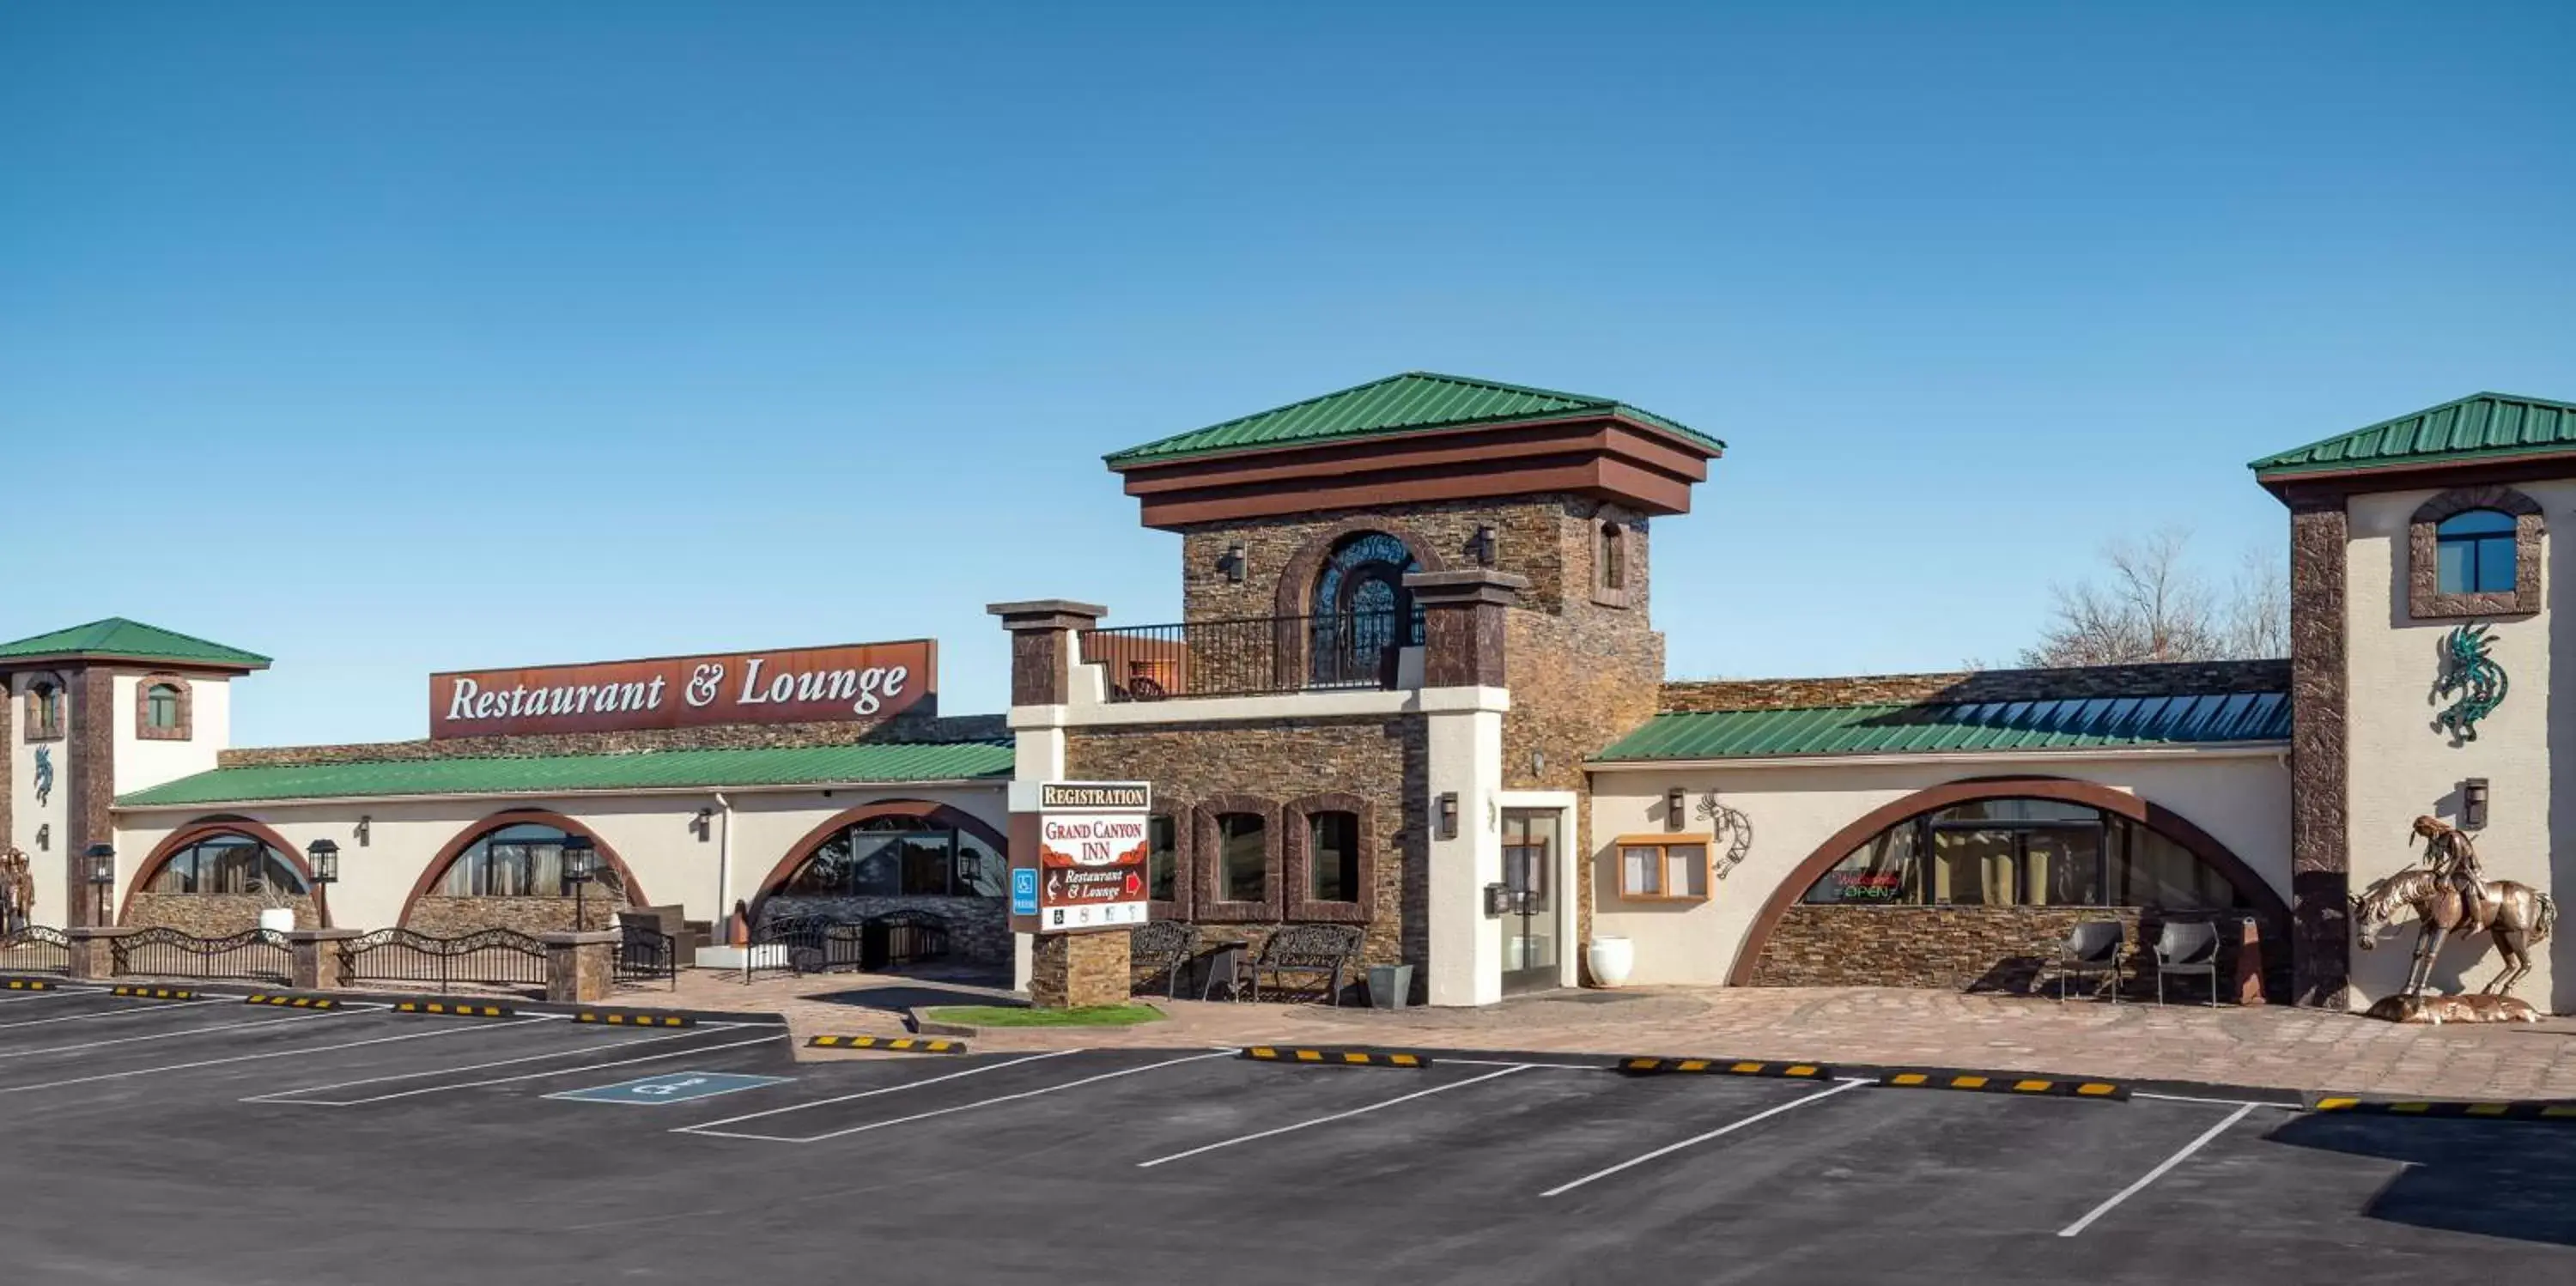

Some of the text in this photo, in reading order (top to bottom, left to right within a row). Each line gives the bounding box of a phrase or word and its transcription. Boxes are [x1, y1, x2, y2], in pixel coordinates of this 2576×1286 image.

[446, 659, 907, 720] Restaurant & Lounge
[1044, 786, 1145, 804] REGISTRATION
[1046, 821, 1142, 840] GRAND CANYON
[1082, 842, 1110, 860] INN
[1065, 870, 1123, 883] Restaurant
[1067, 883, 1120, 900] & Lounge
[1844, 885, 1888, 897] OPEN
